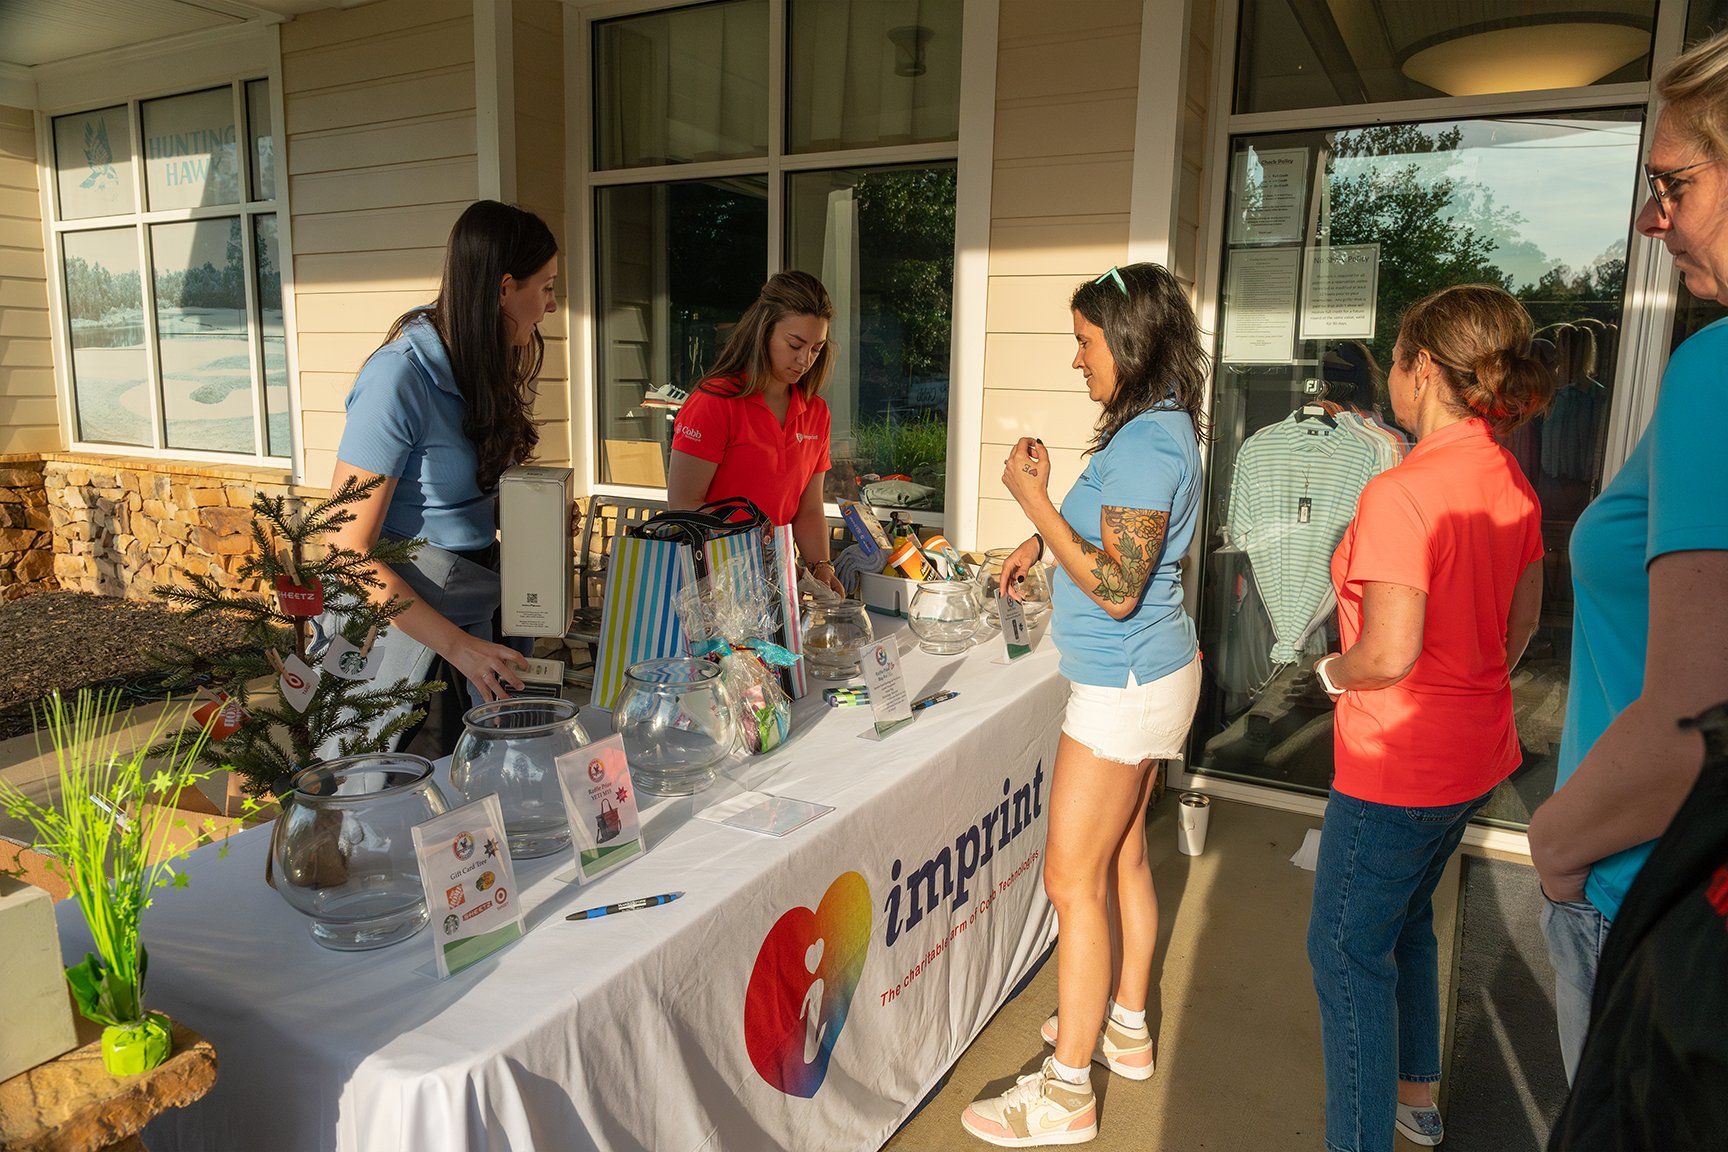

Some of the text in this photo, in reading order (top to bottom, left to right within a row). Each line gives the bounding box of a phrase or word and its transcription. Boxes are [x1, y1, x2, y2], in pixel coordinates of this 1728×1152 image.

[149, 125, 236, 160] HUNTING
[682, 426, 702, 439] Cobb
[450, 859, 487, 880] Gift Card Tree
[884, 758, 1044, 947] imprint
[881, 850, 1040, 1007] The charitable arm of Cobb Technologies
